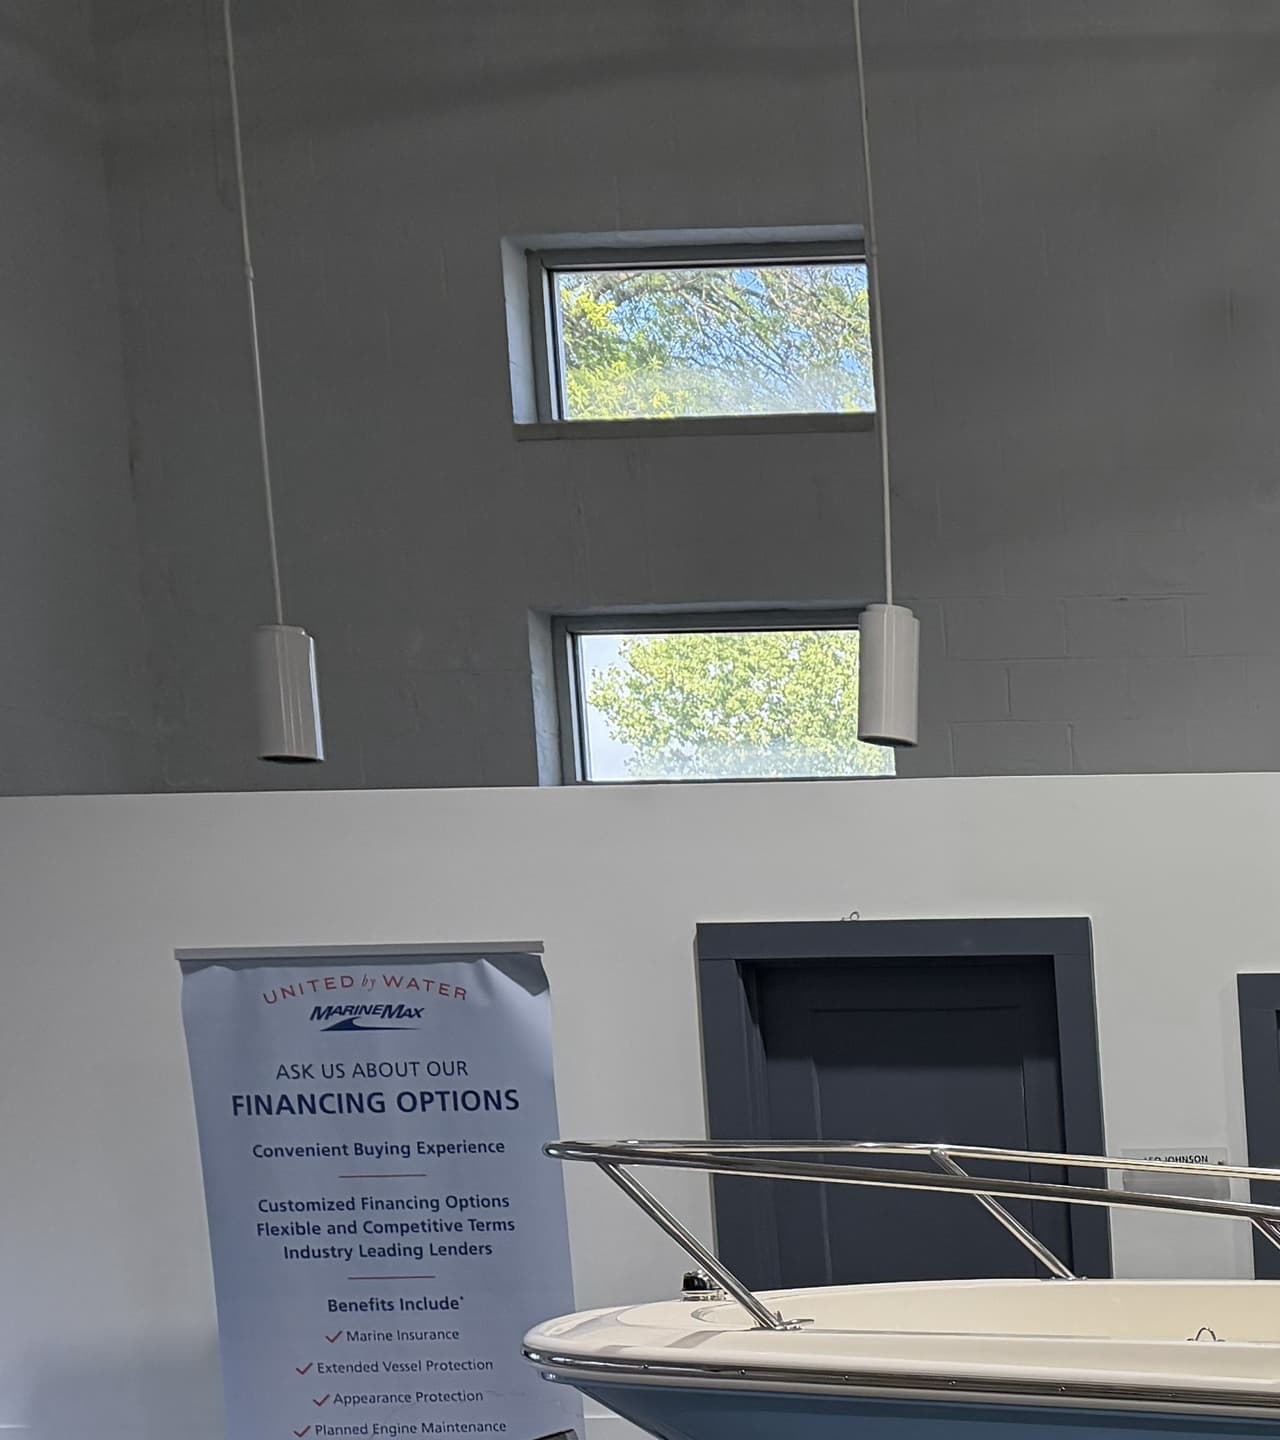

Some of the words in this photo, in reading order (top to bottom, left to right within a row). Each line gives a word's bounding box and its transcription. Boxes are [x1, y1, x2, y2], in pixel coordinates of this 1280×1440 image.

[263, 975, 355, 1005] UNITED
[361, 973, 376, 990] by
[383, 974, 467, 1001] WATER
[276, 1063, 314, 1081] ASK
[321, 1062, 345, 1079] US
[352, 1061, 420, 1079] ABOUT
[427, 1060, 469, 1077] OUR
[232, 1092, 386, 1117] FINANCING
[398, 1089, 520, 1113] OPTIONS
[253, 1142, 349, 1159] Convenient
[354, 1141, 411, 1159] Buying
[417, 1140, 505, 1157] Experience
[258, 1197, 356, 1214] Customized
[361, 1195, 440, 1212] Financing
[446, 1193, 510, 1211] Options
[257, 1221, 321, 1237] Flexible
[326, 1220, 358, 1236] and
[363, 1218, 463, 1236] Competitive
[468, 1217, 515, 1233] Terms
[284, 1244, 353, 1261] Industry
[359, 1243, 424, 1260] Leading
[430, 1242, 493, 1258] Lenders
[328, 1297, 394, 1313] Benefits
[346, 1329, 393, 1342] Marine
[397, 1328, 460, 1341] Insurance
[317, 1361, 379, 1375] Extended
[383, 1359, 422, 1373] Vessel
[426, 1358, 494, 1372] Protection
[333, 1392, 412, 1408] Appearance
[416, 1389, 484, 1403] Protection
[315, 1423, 368, 1437] Planned
[373, 1422, 417, 1438] Engine
[421, 1420, 507, 1434] Maintenance
